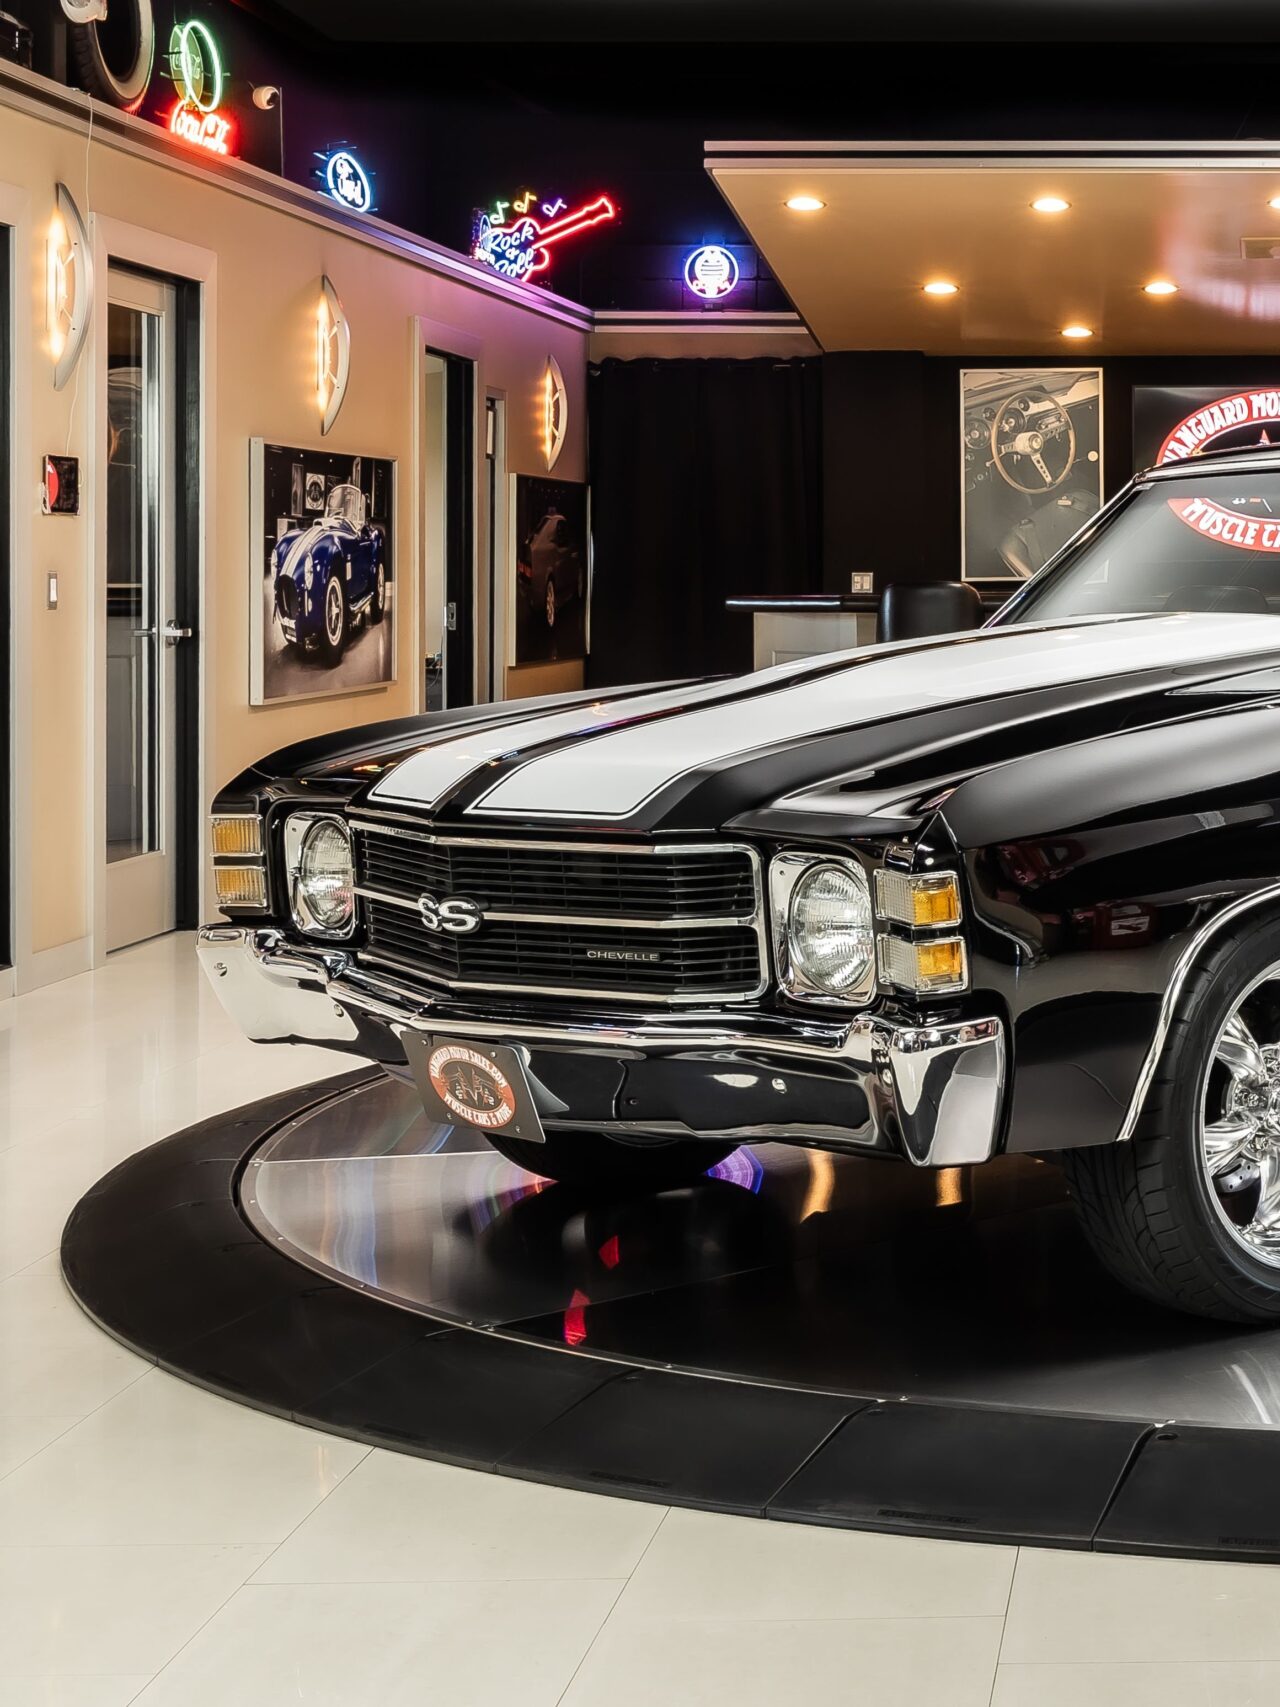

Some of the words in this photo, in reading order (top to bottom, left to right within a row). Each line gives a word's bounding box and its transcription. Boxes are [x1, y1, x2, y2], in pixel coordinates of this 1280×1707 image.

[488, 220, 535, 253] Rock
[1181, 498, 1260, 545] MUSCLE
[417, 896, 480, 932] SS
[586, 950, 659, 962] CHEVELLE
